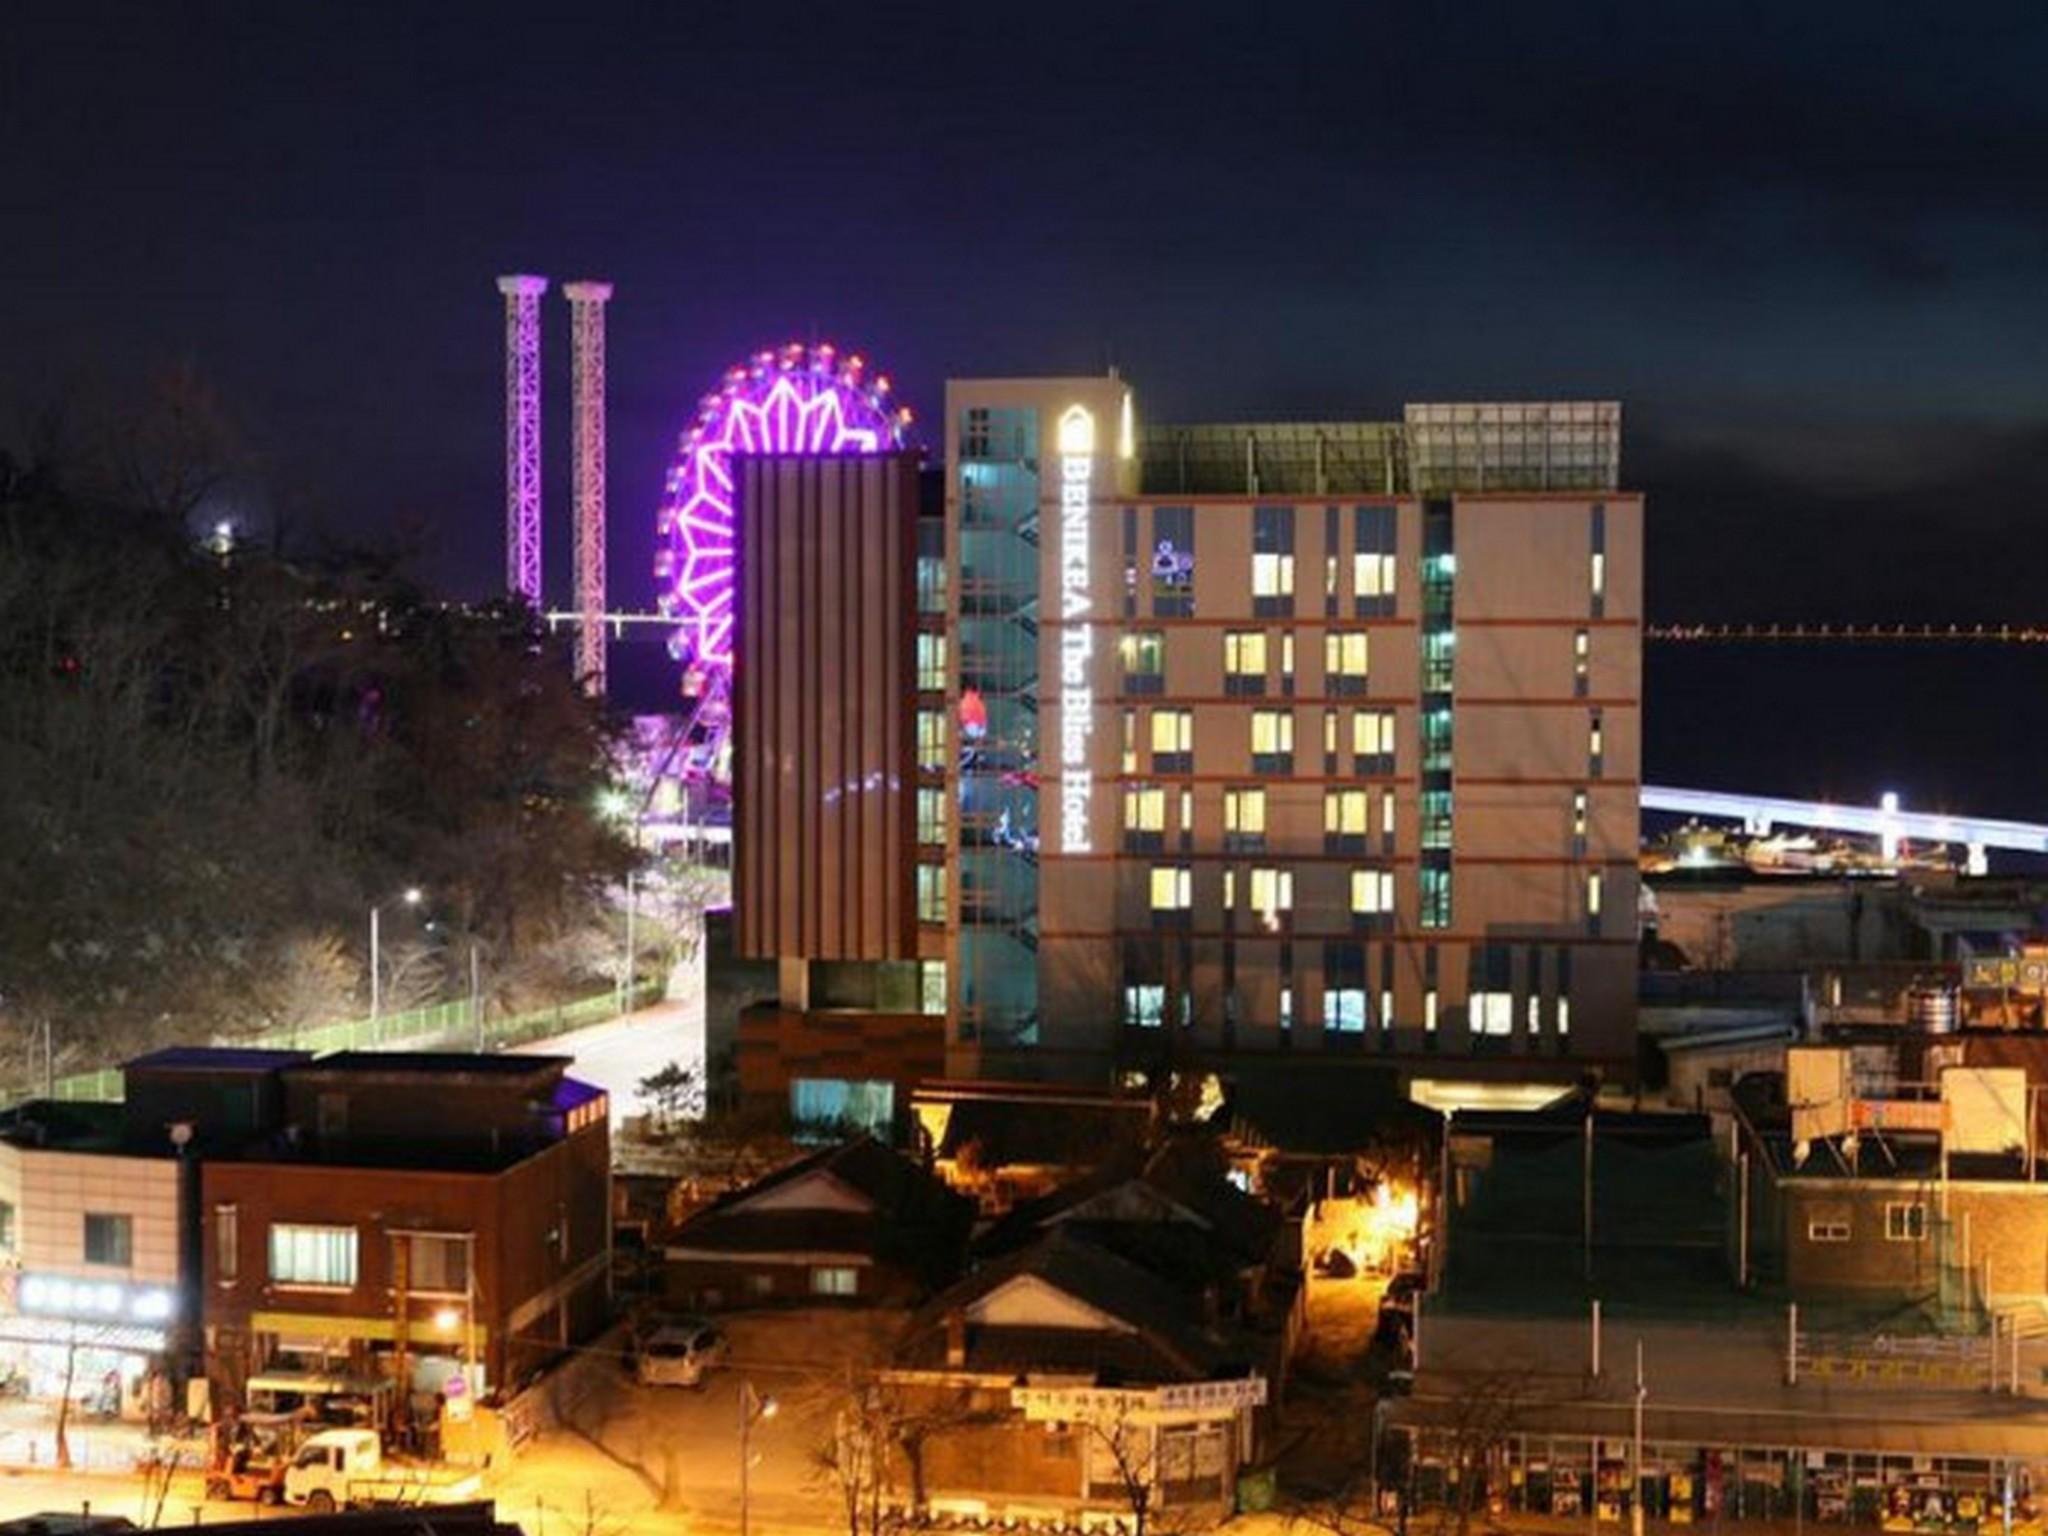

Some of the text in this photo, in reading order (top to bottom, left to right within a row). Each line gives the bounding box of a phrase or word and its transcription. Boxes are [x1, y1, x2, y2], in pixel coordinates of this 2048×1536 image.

[1060, 457, 1092, 853] BENIKEA The Bliss Hotel
